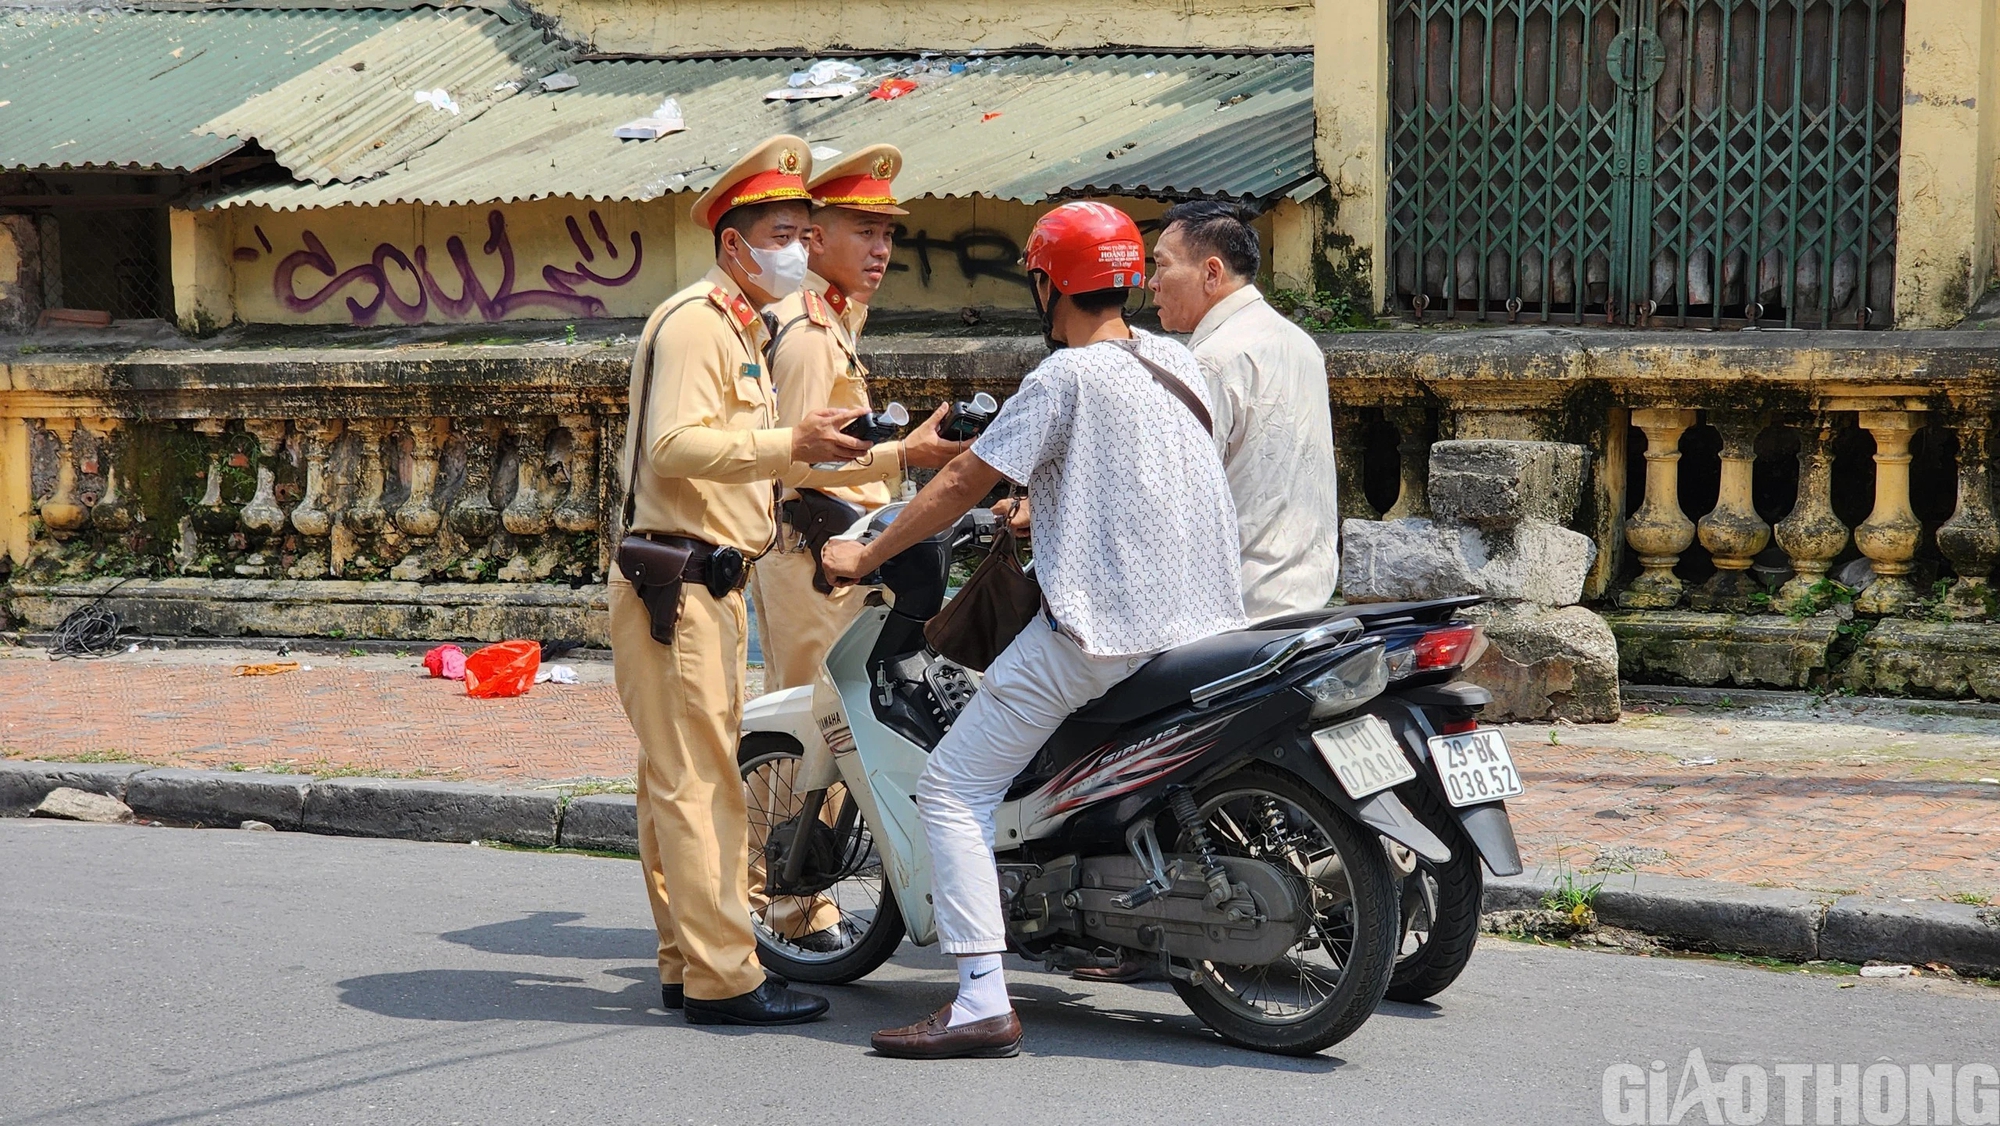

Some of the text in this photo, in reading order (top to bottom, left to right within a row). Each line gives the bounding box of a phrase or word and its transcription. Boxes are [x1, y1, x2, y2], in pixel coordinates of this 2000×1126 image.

[1100, 725, 1180, 765] SIRIUS
[1441, 734, 1500, 769] 29-BK
[1448, 764, 1518, 801] 038.52
